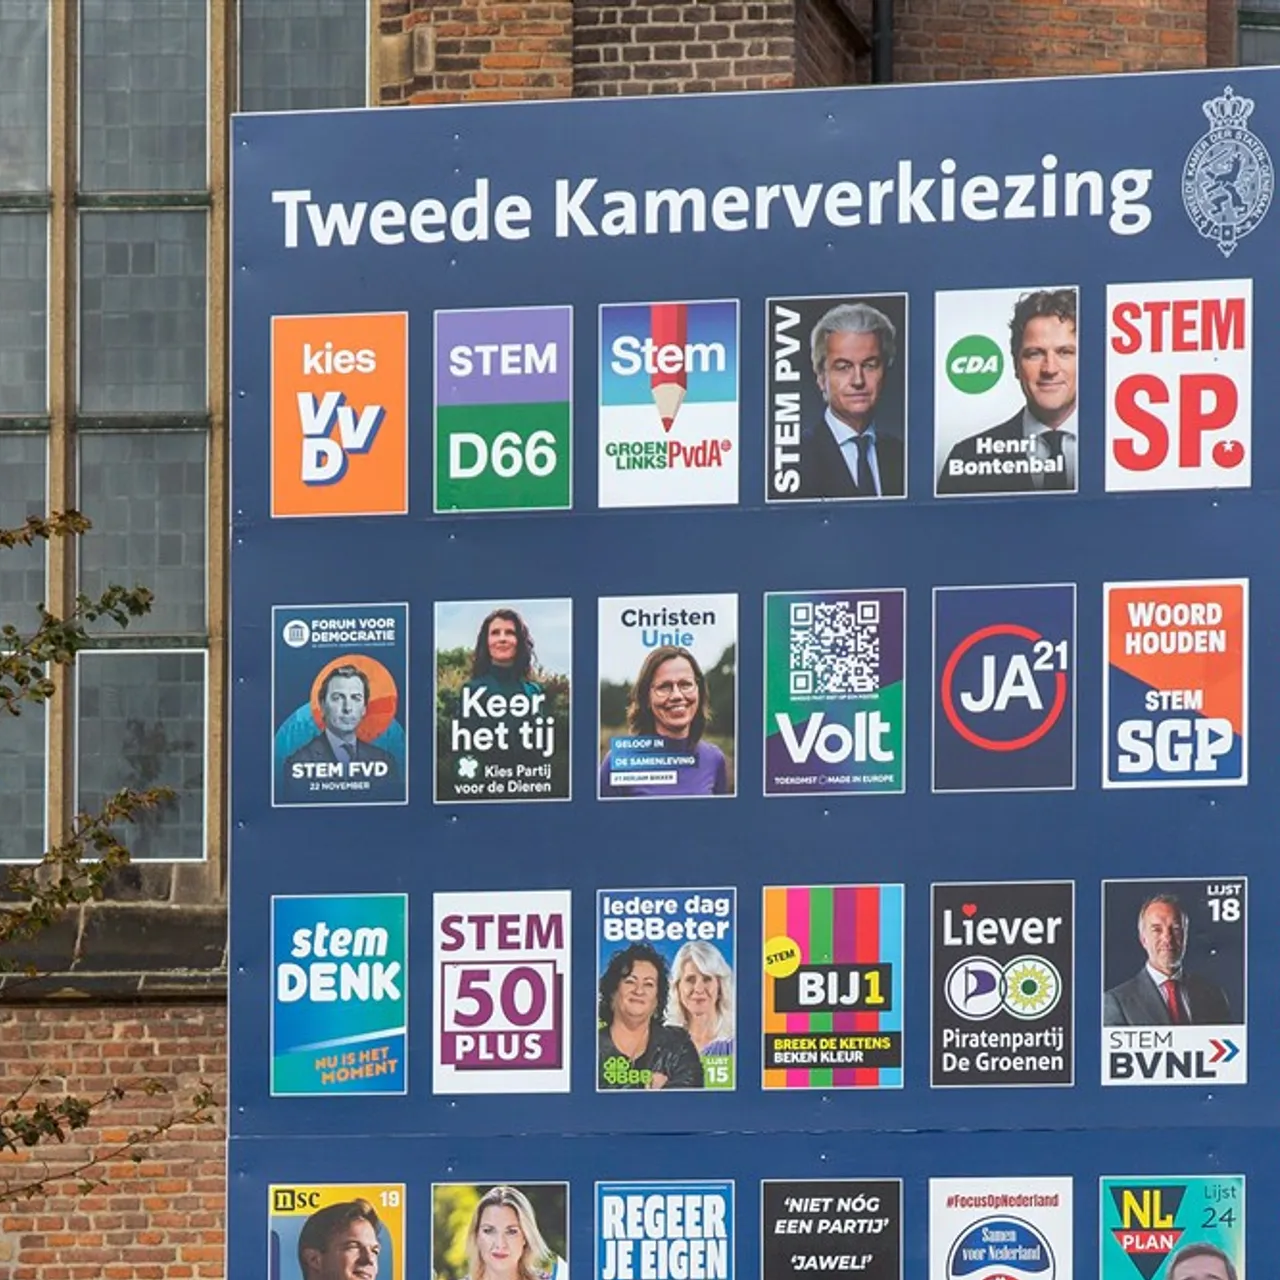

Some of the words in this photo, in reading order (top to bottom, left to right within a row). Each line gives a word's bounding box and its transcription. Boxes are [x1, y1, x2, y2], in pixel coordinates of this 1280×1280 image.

[272, 178, 531, 248] Tweede
[555, 154, 1152, 237] Kamerverkiezing
[1111, 298, 1246, 356] STEM
[775, 305, 801, 382] PVV
[303, 343, 376, 375] kies
[449, 343, 558, 376] STEM
[611, 335, 726, 376] Stem
[951, 354, 999, 376] CDA
[606, 440, 667, 458] GROEN
[775, 387, 801, 493] STEM
[975, 435, 1037, 456] Henri
[448, 431, 557, 480] D66
[615, 454, 667, 470] LINKS
[669, 440, 722, 469] PvdA
[948, 454, 1064, 476] Bontenbal
[312, 619, 355, 630] FORUM
[359, 618, 395, 628] VOOR
[621, 608, 716, 628] Christen
[1127, 602, 1222, 627] WOORD
[312, 630, 395, 642] DEMOCRATIE
[641, 628, 694, 648] Unie
[1126, 630, 1226, 655] HOUDEN
[1145, 689, 1202, 711] STEM
[452, 719, 508, 750] het
[519, 717, 555, 757] tij
[654, 739, 664, 747] IN
[775, 710, 894, 763] Volt
[1118, 718, 1232, 773] SGP
[292, 762, 343, 779] STEM
[348, 761, 388, 778] FVD
[485, 764, 512, 778] Kies
[517, 763, 551, 778] Partij
[827, 776, 850, 784] MADE
[863, 775, 894, 783] EUROPE
[454, 784, 484, 795] voor
[488, 782, 504, 794] de
[508, 781, 551, 793] Dieren
[1208, 884, 1242, 896] LIJST
[604, 897, 676, 915] Iedere
[684, 895, 729, 915] dag
[1208, 898, 1240, 923] 18
[441, 914, 563, 951] STEM
[604, 917, 729, 941] BBBeter
[943, 904, 1062, 946] Liever
[291, 922, 388, 958] stem
[766, 949, 795, 965] STEM
[278, 962, 401, 1002] DENK
[798, 970, 884, 1006] BIJ1
[453, 967, 547, 1027] 50
[456, 1034, 542, 1060] PLUS
[774, 1038, 816, 1050] BREEK
[820, 1038, 836, 1050] DE
[840, 1037, 891, 1049] KETENS
[943, 1027, 1064, 1053] Piratenpartij
[1110, 1030, 1173, 1049] STEM
[315, 1056, 337, 1070] NU
[342, 1052, 355, 1066] IS
[359, 1047, 389, 1063] HET
[774, 1051, 816, 1063] BEKEN
[820, 1051, 863, 1063] KLEUR
[943, 1054, 970, 1072] De
[976, 1052, 1064, 1072] Groenen
[1110, 1051, 1216, 1079] BVNL
[321, 1060, 398, 1085] MOMENT
[707, 1067, 728, 1083] 15
[837, 1193, 880, 1213] NÓG
[946, 1193, 1059, 1209] #FocusOpNederland
[1204, 1185, 1236, 1202] Lijst
[602, 1194, 727, 1239] REGEER
[1122, 1189, 1173, 1228] NL
[1201, 1207, 1236, 1229] 24
[774, 1219, 812, 1235] EEN
[981, 1227, 1016, 1243] Samen
[1123, 1232, 1173, 1250] PLAN
[602, 1240, 634, 1280] JE
[641, 1239, 727, 1280] EIGEN
[962, 1248, 986, 1261] voor
[988, 1245, 1041, 1261] Nederland
